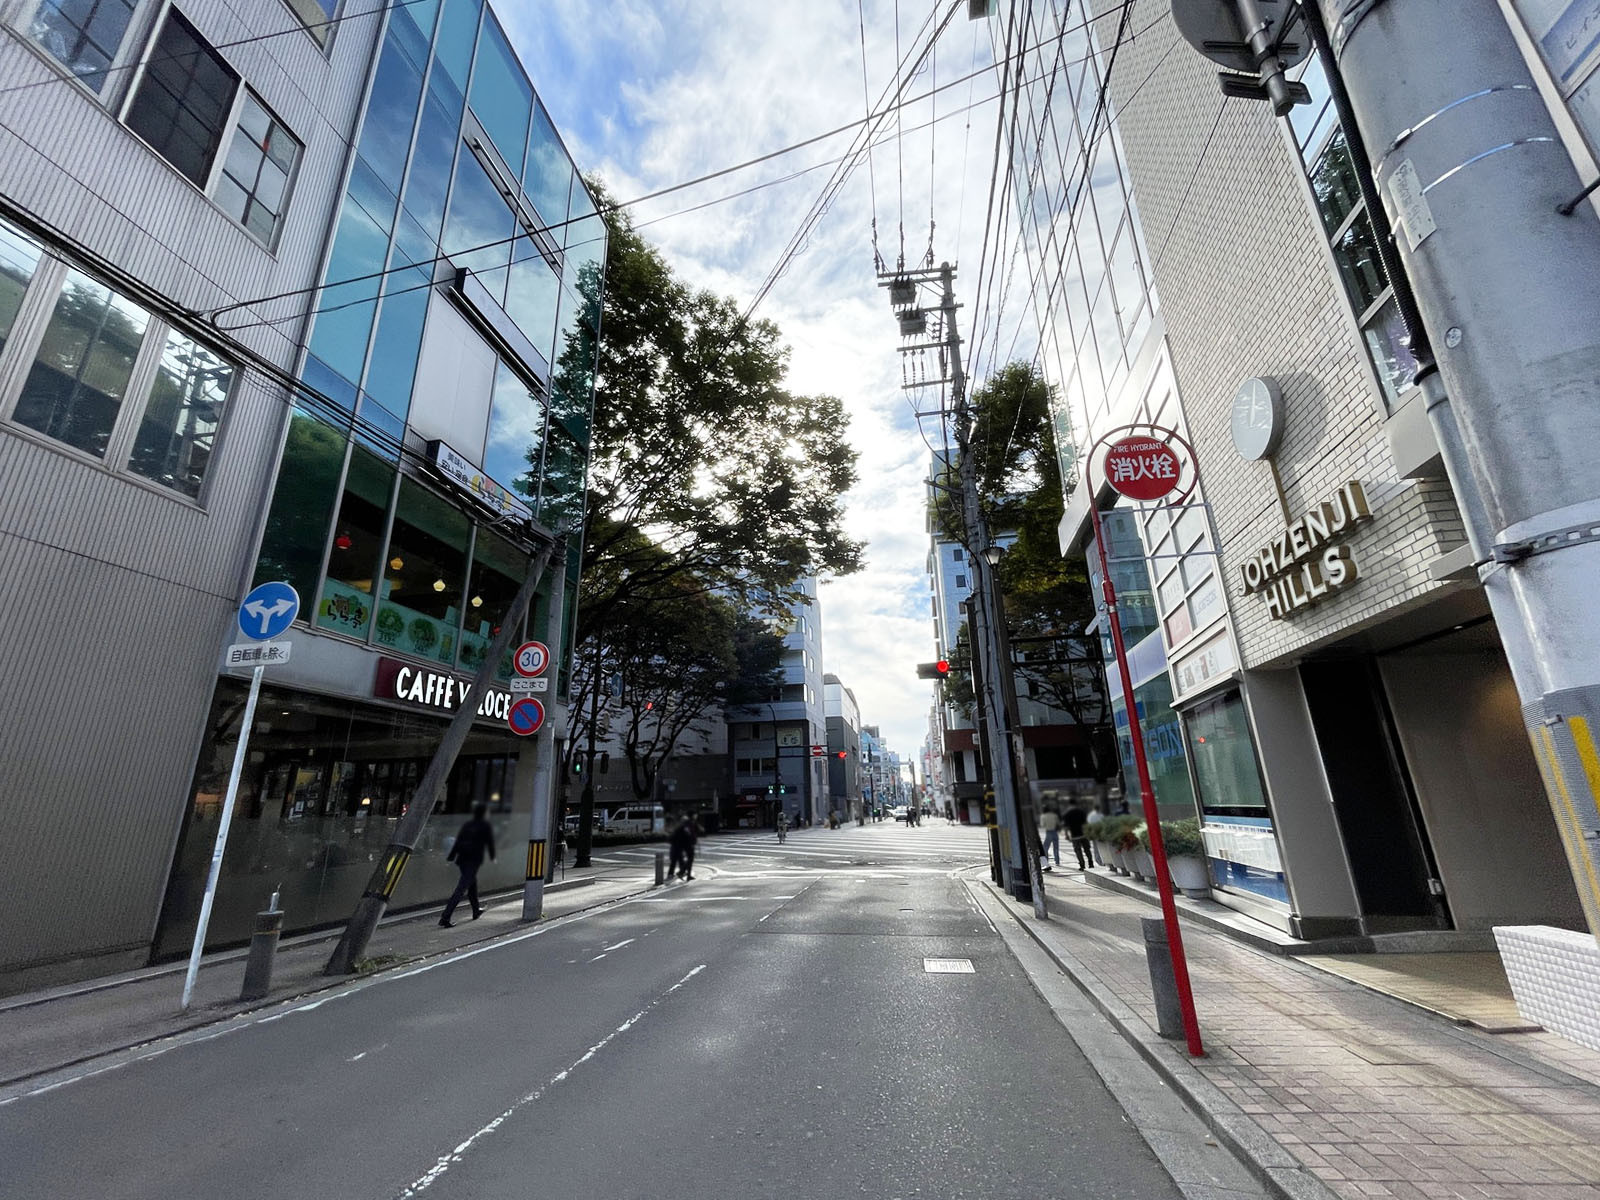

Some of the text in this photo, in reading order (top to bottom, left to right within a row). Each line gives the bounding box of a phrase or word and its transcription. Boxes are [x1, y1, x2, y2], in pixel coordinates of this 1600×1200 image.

[1113, 442, 1163, 453] FIRE HYDRANT
[1110, 453, 1176, 482] 消火栓
[1238, 480, 1369, 597] JOHZENJI
[1263, 545, 1355, 620] HILLS
[231, 647, 285, 662] 自転車を除く
[521, 651, 541, 667] 30
[396, 666, 455, 709] CAFFÈ
[513, 680, 545, 689] ここまで
